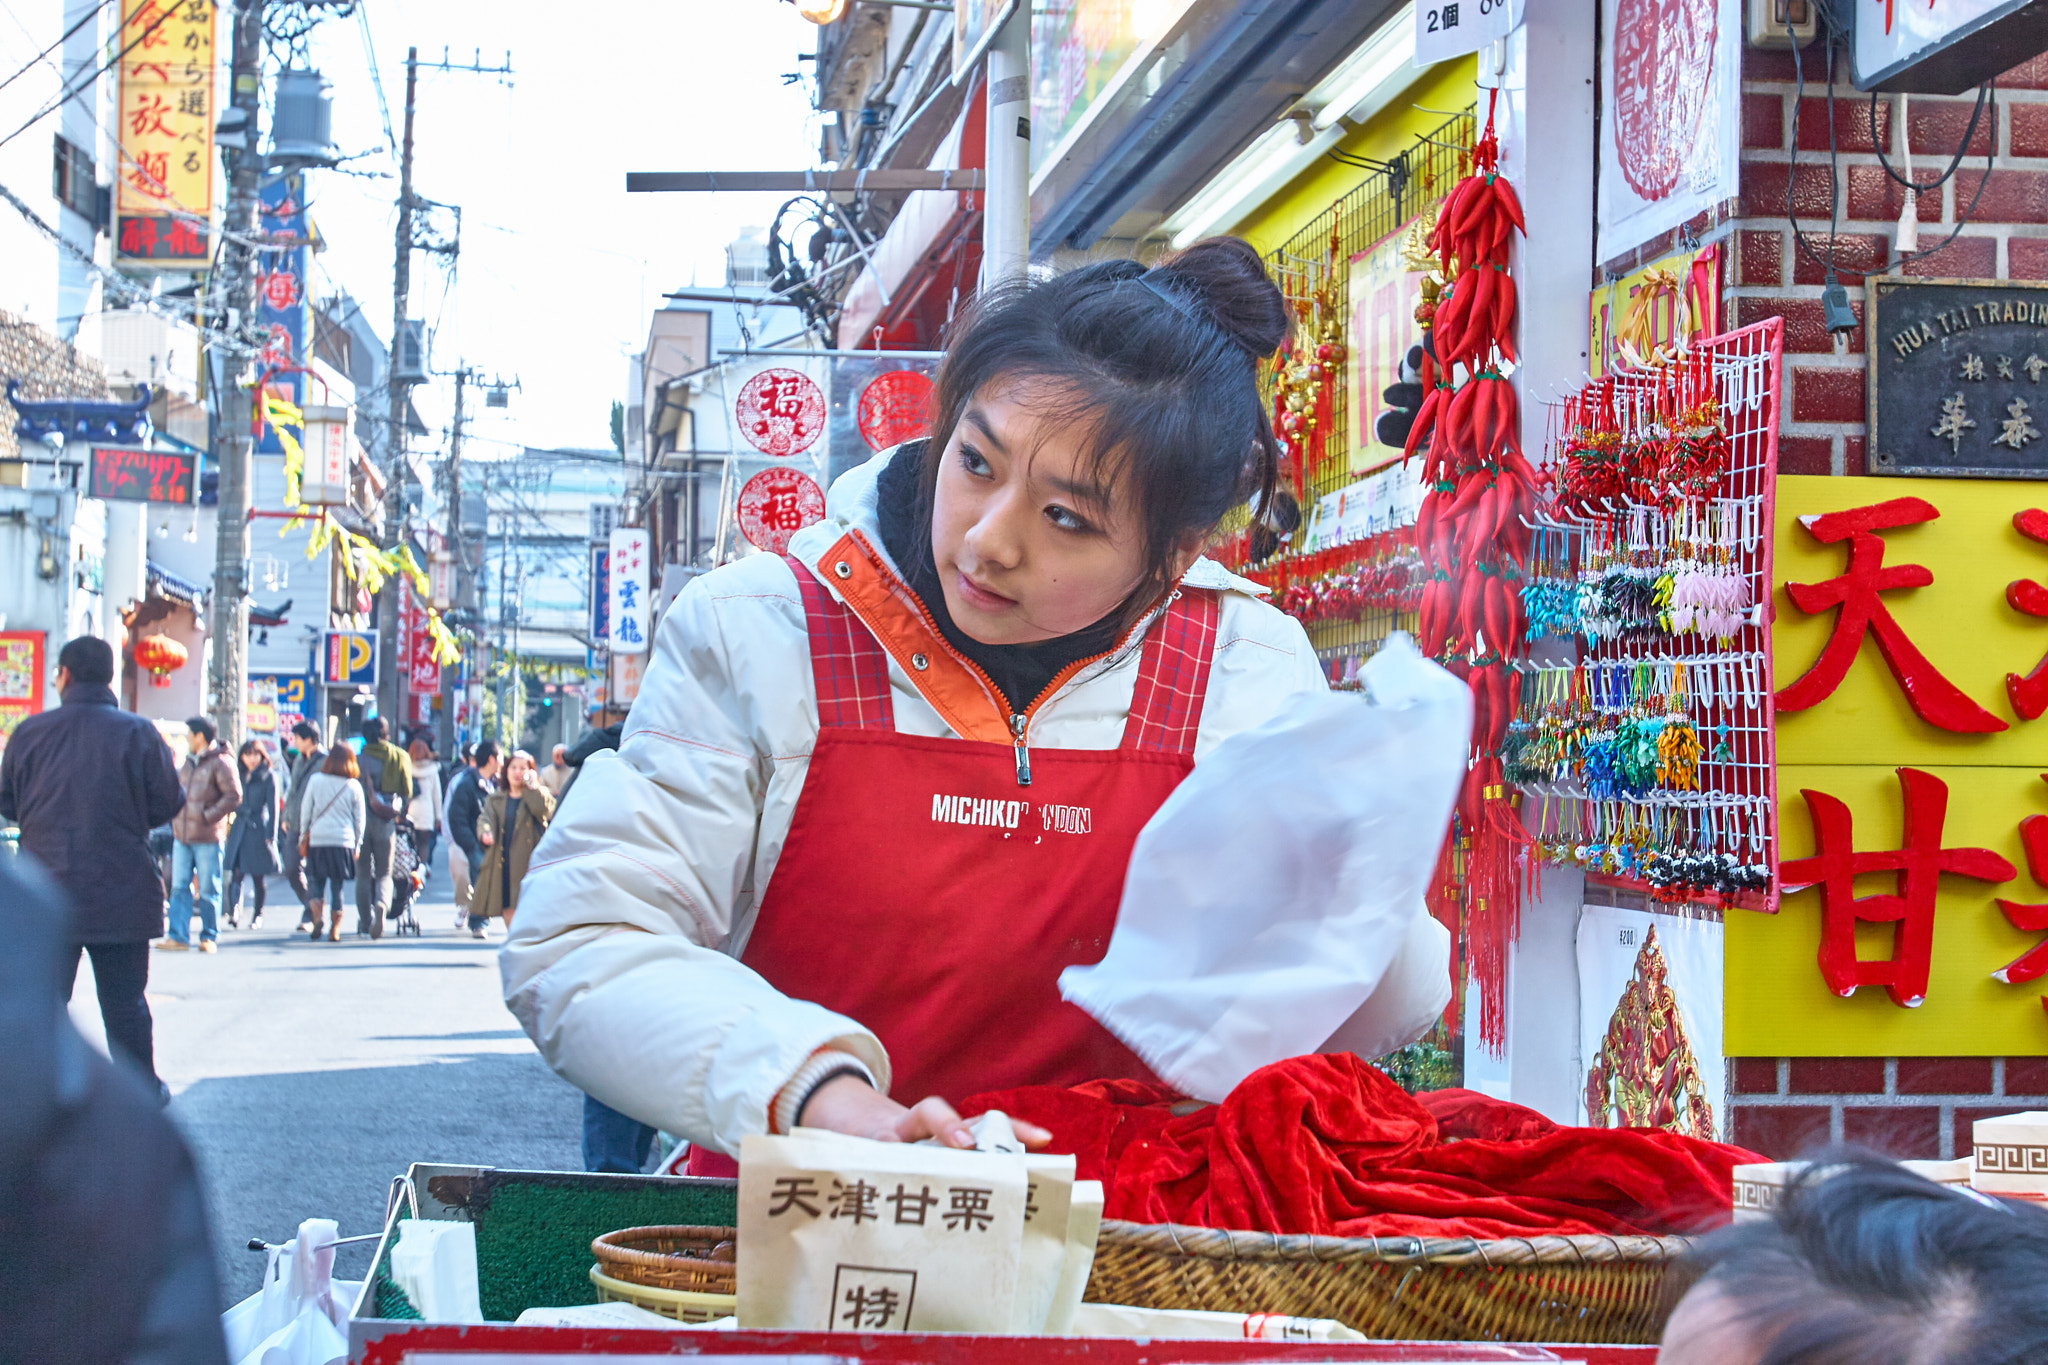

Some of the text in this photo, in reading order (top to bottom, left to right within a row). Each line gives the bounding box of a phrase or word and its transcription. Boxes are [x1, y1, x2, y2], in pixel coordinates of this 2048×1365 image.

[1427, 2, 1459, 33] 2個
[1892, 321, 1936, 358] HUA
[1937, 306, 1971, 334] TAI
[760, 484, 802, 531] 福
[615, 580, 643, 644] 雲龍
[1775, 496, 2048, 734] 天
[931, 793, 1020, 829] MICHIKO
[1779, 766, 2048, 1009] 甘
[768, 1176, 994, 1232] 天津甘栗
[842, 1284, 899, 1329] 特
